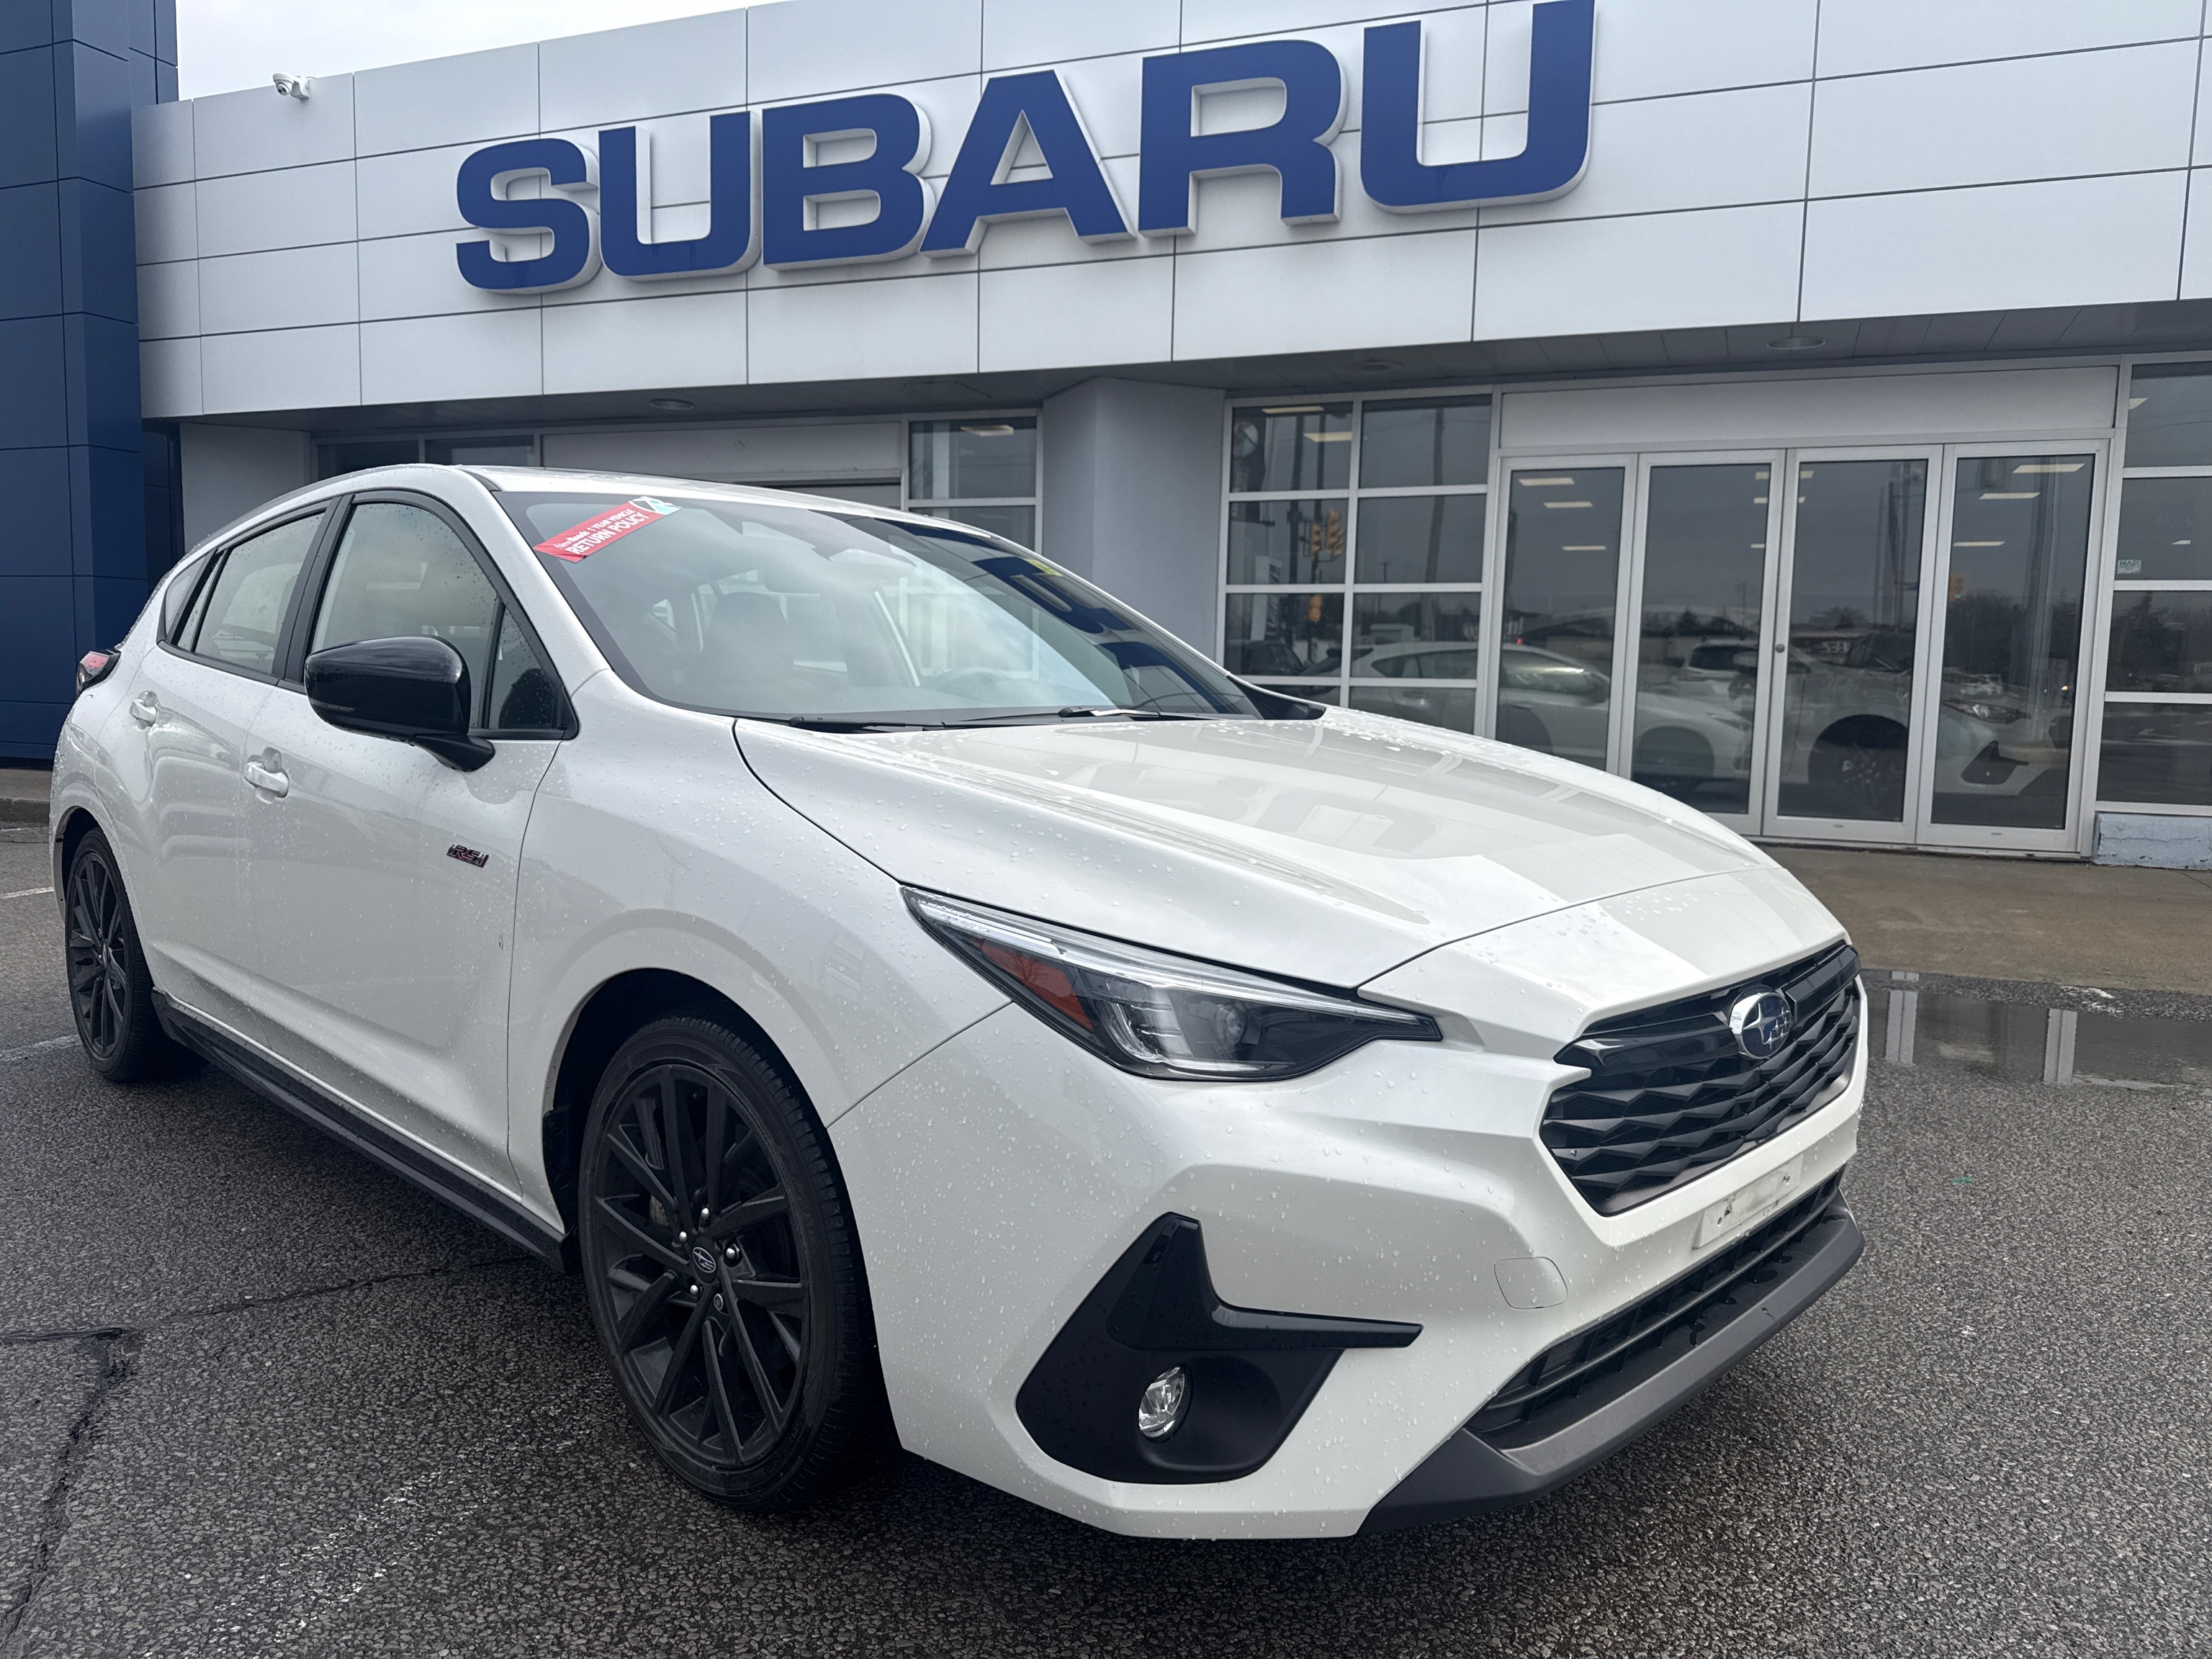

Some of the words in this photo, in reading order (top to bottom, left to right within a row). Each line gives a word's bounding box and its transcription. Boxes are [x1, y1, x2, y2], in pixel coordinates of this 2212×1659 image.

[456, 0, 1596, 290] SUBARU
[553, 531, 590, 549] NewRoads
[590, 518, 611, 529] YEAR
[607, 508, 635, 523] VEHICLE
[565, 529, 617, 554] RETURN
[608, 512, 649, 532] POLICY
